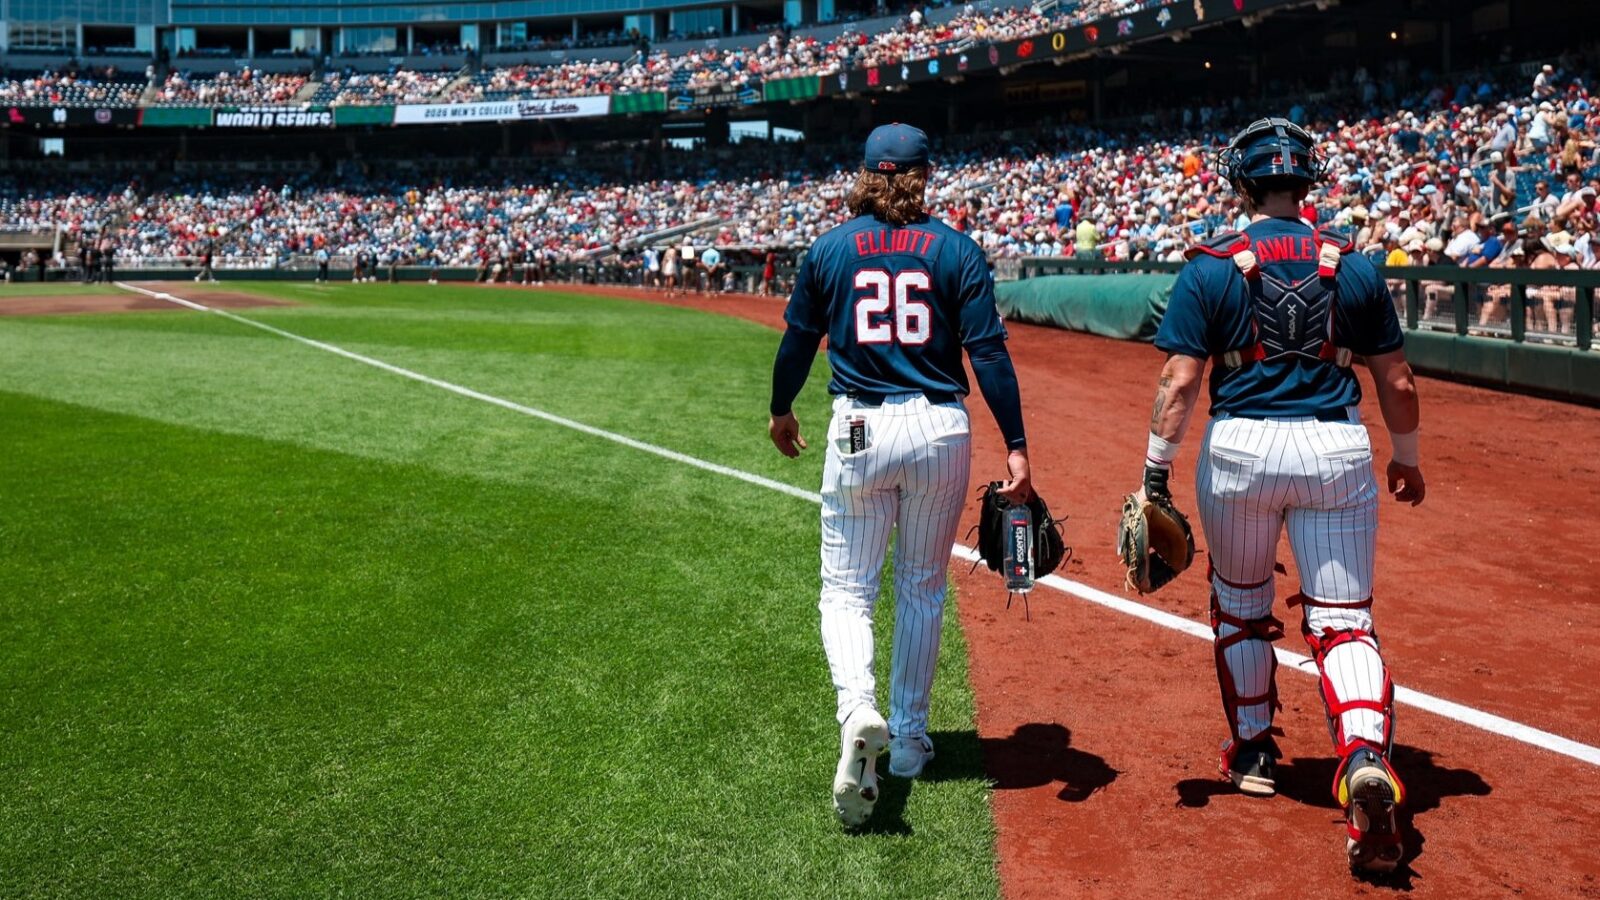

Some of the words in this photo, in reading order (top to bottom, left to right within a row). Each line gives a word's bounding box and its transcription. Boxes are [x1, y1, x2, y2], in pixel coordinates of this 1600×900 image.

[276, 111, 332, 127] SERIES
[451, 106, 477, 116] MEN'S
[479, 105, 513, 116] COLLEGE
[854, 228, 936, 257] ELLIOTT
[853, 267, 933, 346] 26
[1015, 526, 1025, 563] essentia
